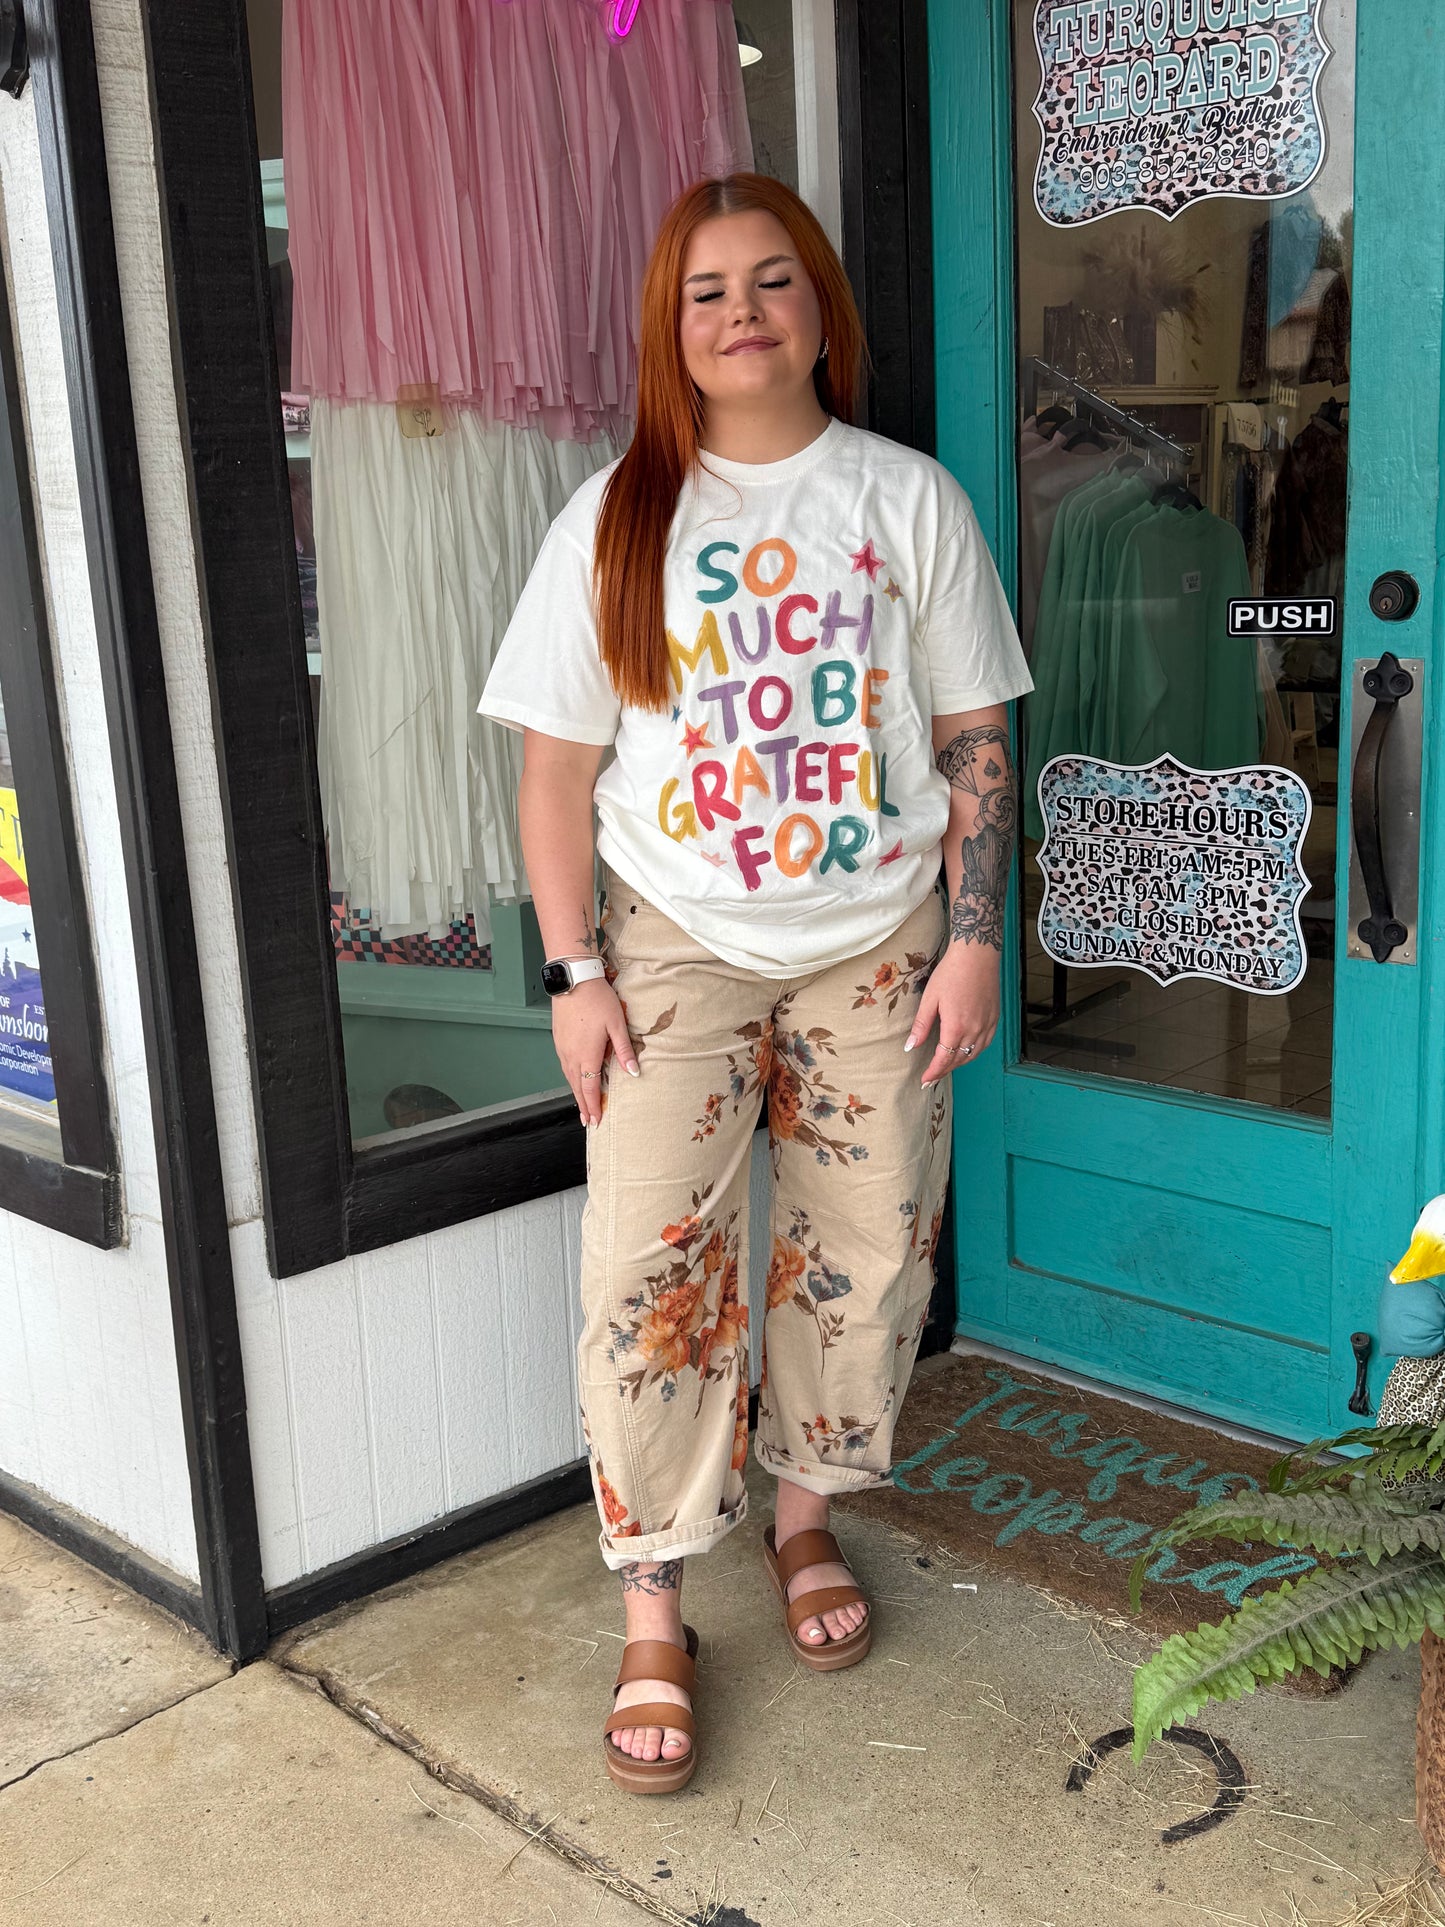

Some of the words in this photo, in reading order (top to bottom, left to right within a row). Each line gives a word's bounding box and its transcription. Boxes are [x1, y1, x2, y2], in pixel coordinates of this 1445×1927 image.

[1072, 33, 1281, 128] LEOPARD
[1053, 118, 1171, 164] Embroidery
[1177, 114, 1200, 143] &
[1201, 97, 1303, 145] Boutique
[1079, 138, 1270, 194] 903-852-2840
[696, 537, 797, 604] SO
[666, 589, 874, 695] MUCH
[1235, 605, 1328, 629] PUSH
[697, 675, 794, 744] TO
[811, 659, 889, 729] BE
[658, 735, 900, 843] GRATEFUL
[1056, 795, 1159, 831] STORE
[1167, 803, 1288, 840] HOURS
[731, 812, 875, 892] FOR
[1057, 840, 1165, 869] TUES-FRI
[1169, 852, 1285, 881] 9AM-5PM
[1088, 874, 1129, 896] SAT
[1135, 881, 1248, 910] 9AM-3PM
[1117, 908, 1213, 937] CLOSED
[1055, 931, 1145, 959] SUNDAY
[1151, 944, 1169, 964] &
[1175, 946, 1284, 979] MONDAY
